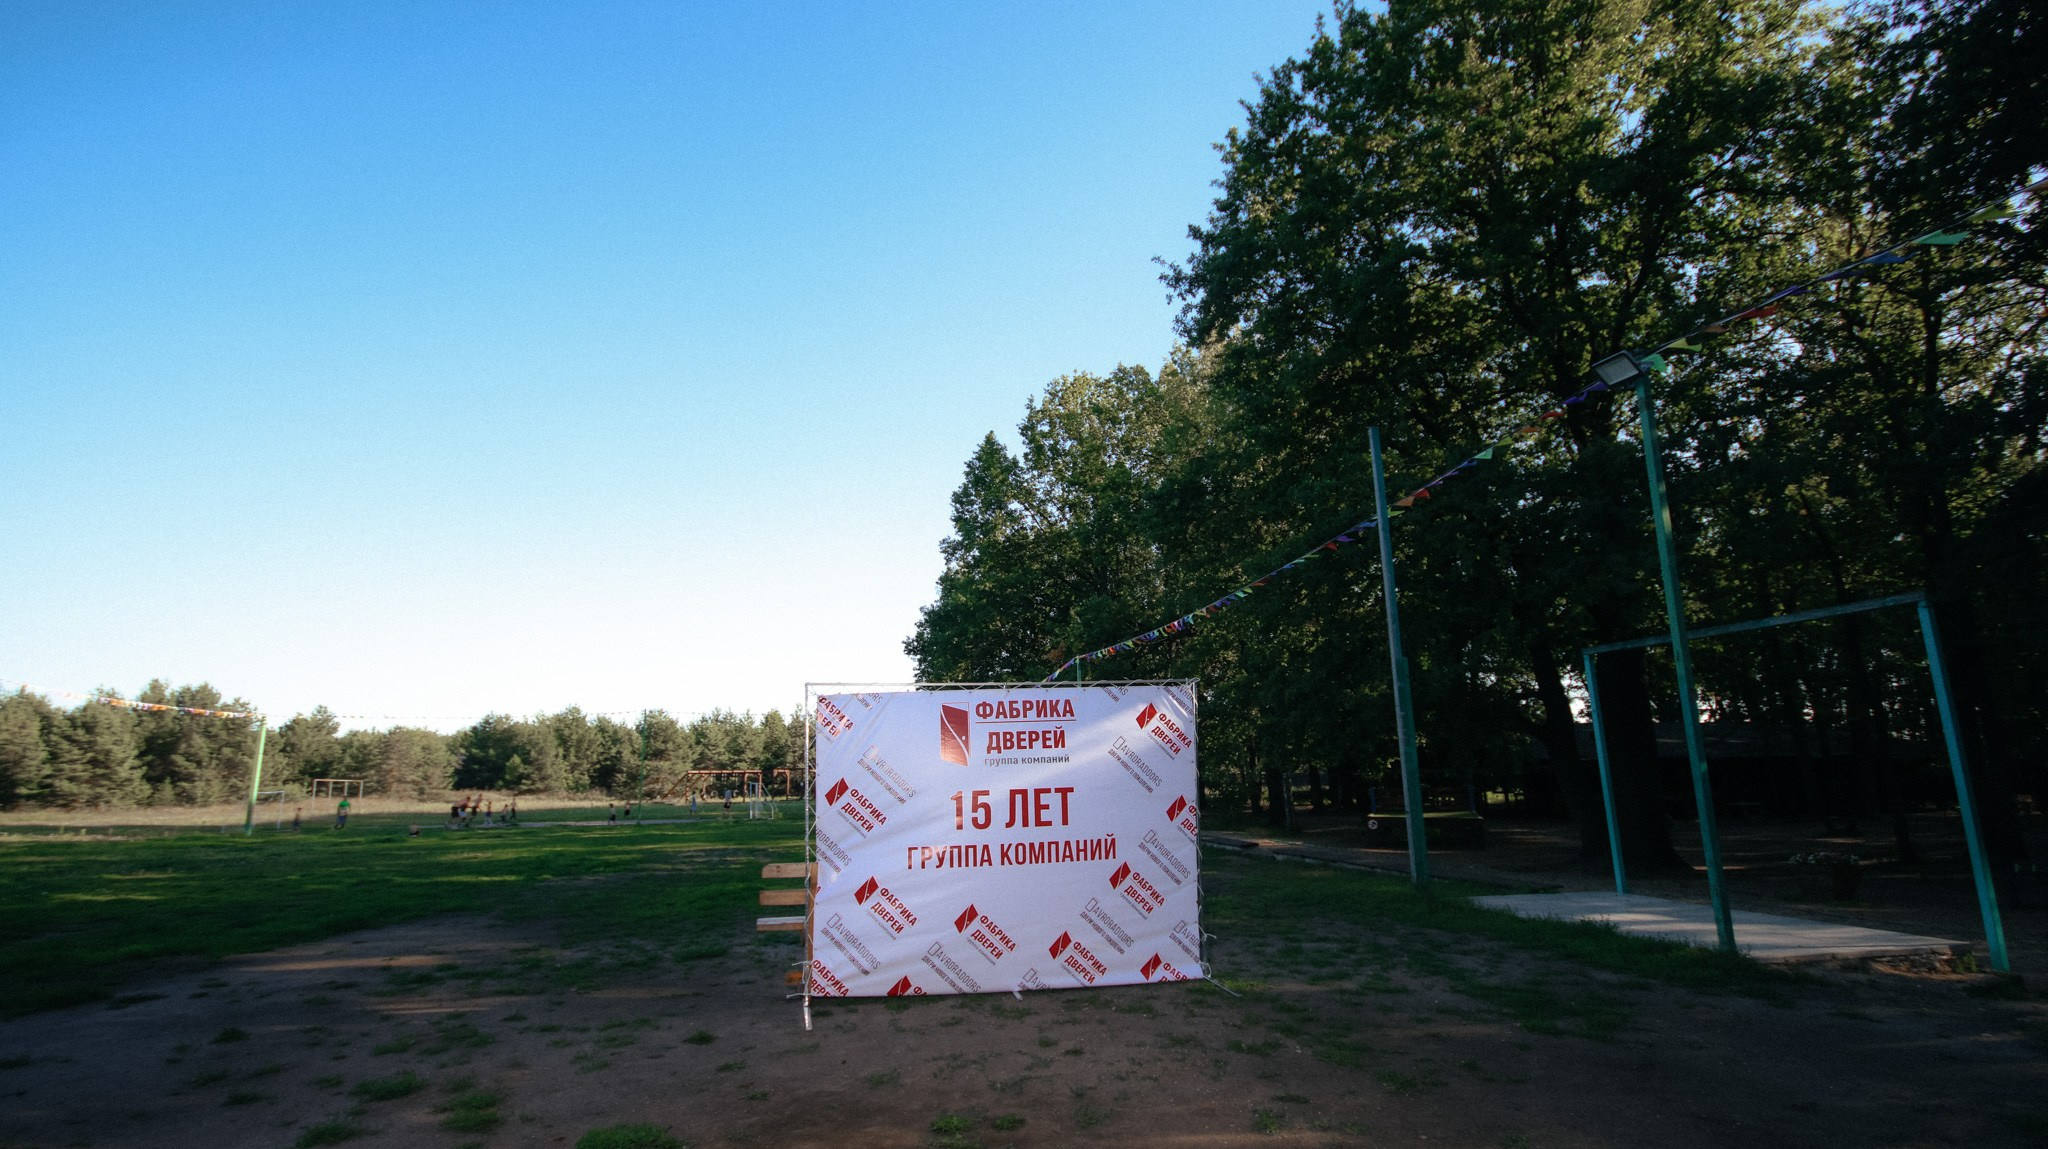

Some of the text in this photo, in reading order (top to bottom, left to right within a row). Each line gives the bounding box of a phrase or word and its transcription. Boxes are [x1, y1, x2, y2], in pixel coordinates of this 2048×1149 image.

[975, 699, 1075, 719] ФАБРИКА
[986, 725, 1066, 754] ДВЕРЕЙ
[1151, 725, 1181, 755] ДВЕРЕЙ
[1158, 713, 1193, 748] ФАБРИКА
[985, 753, 1070, 767] группа компаний
[1120, 745, 1163, 787] AVRORADOORS
[841, 802, 875, 832] ДВЕРЕЙ
[850, 788, 887, 825] ФАБРИКА
[950, 787, 1075, 830] 15 ЛЕТ
[907, 833, 1117, 870] ГРУППА КОМПАНИЙ
[1123, 885, 1154, 914] ДВЕРЕЙ
[1132, 872, 1165, 906] ФАБРИКА
[870, 901, 905, 934] ДВЕРЕЙ
[880, 888, 918, 926] ФАБРИКА
[834, 923, 881, 970] AVRORADOORS
[971, 929, 1004, 960] ДВЕРЕЙ
[980, 915, 1016, 951] ФАБРИКА
[1064, 954, 1096, 985] ДВЕРЕЙ
[1073, 941, 1108, 976] ФАБРИКА
[812, 959, 849, 997] ФАБРИКА
